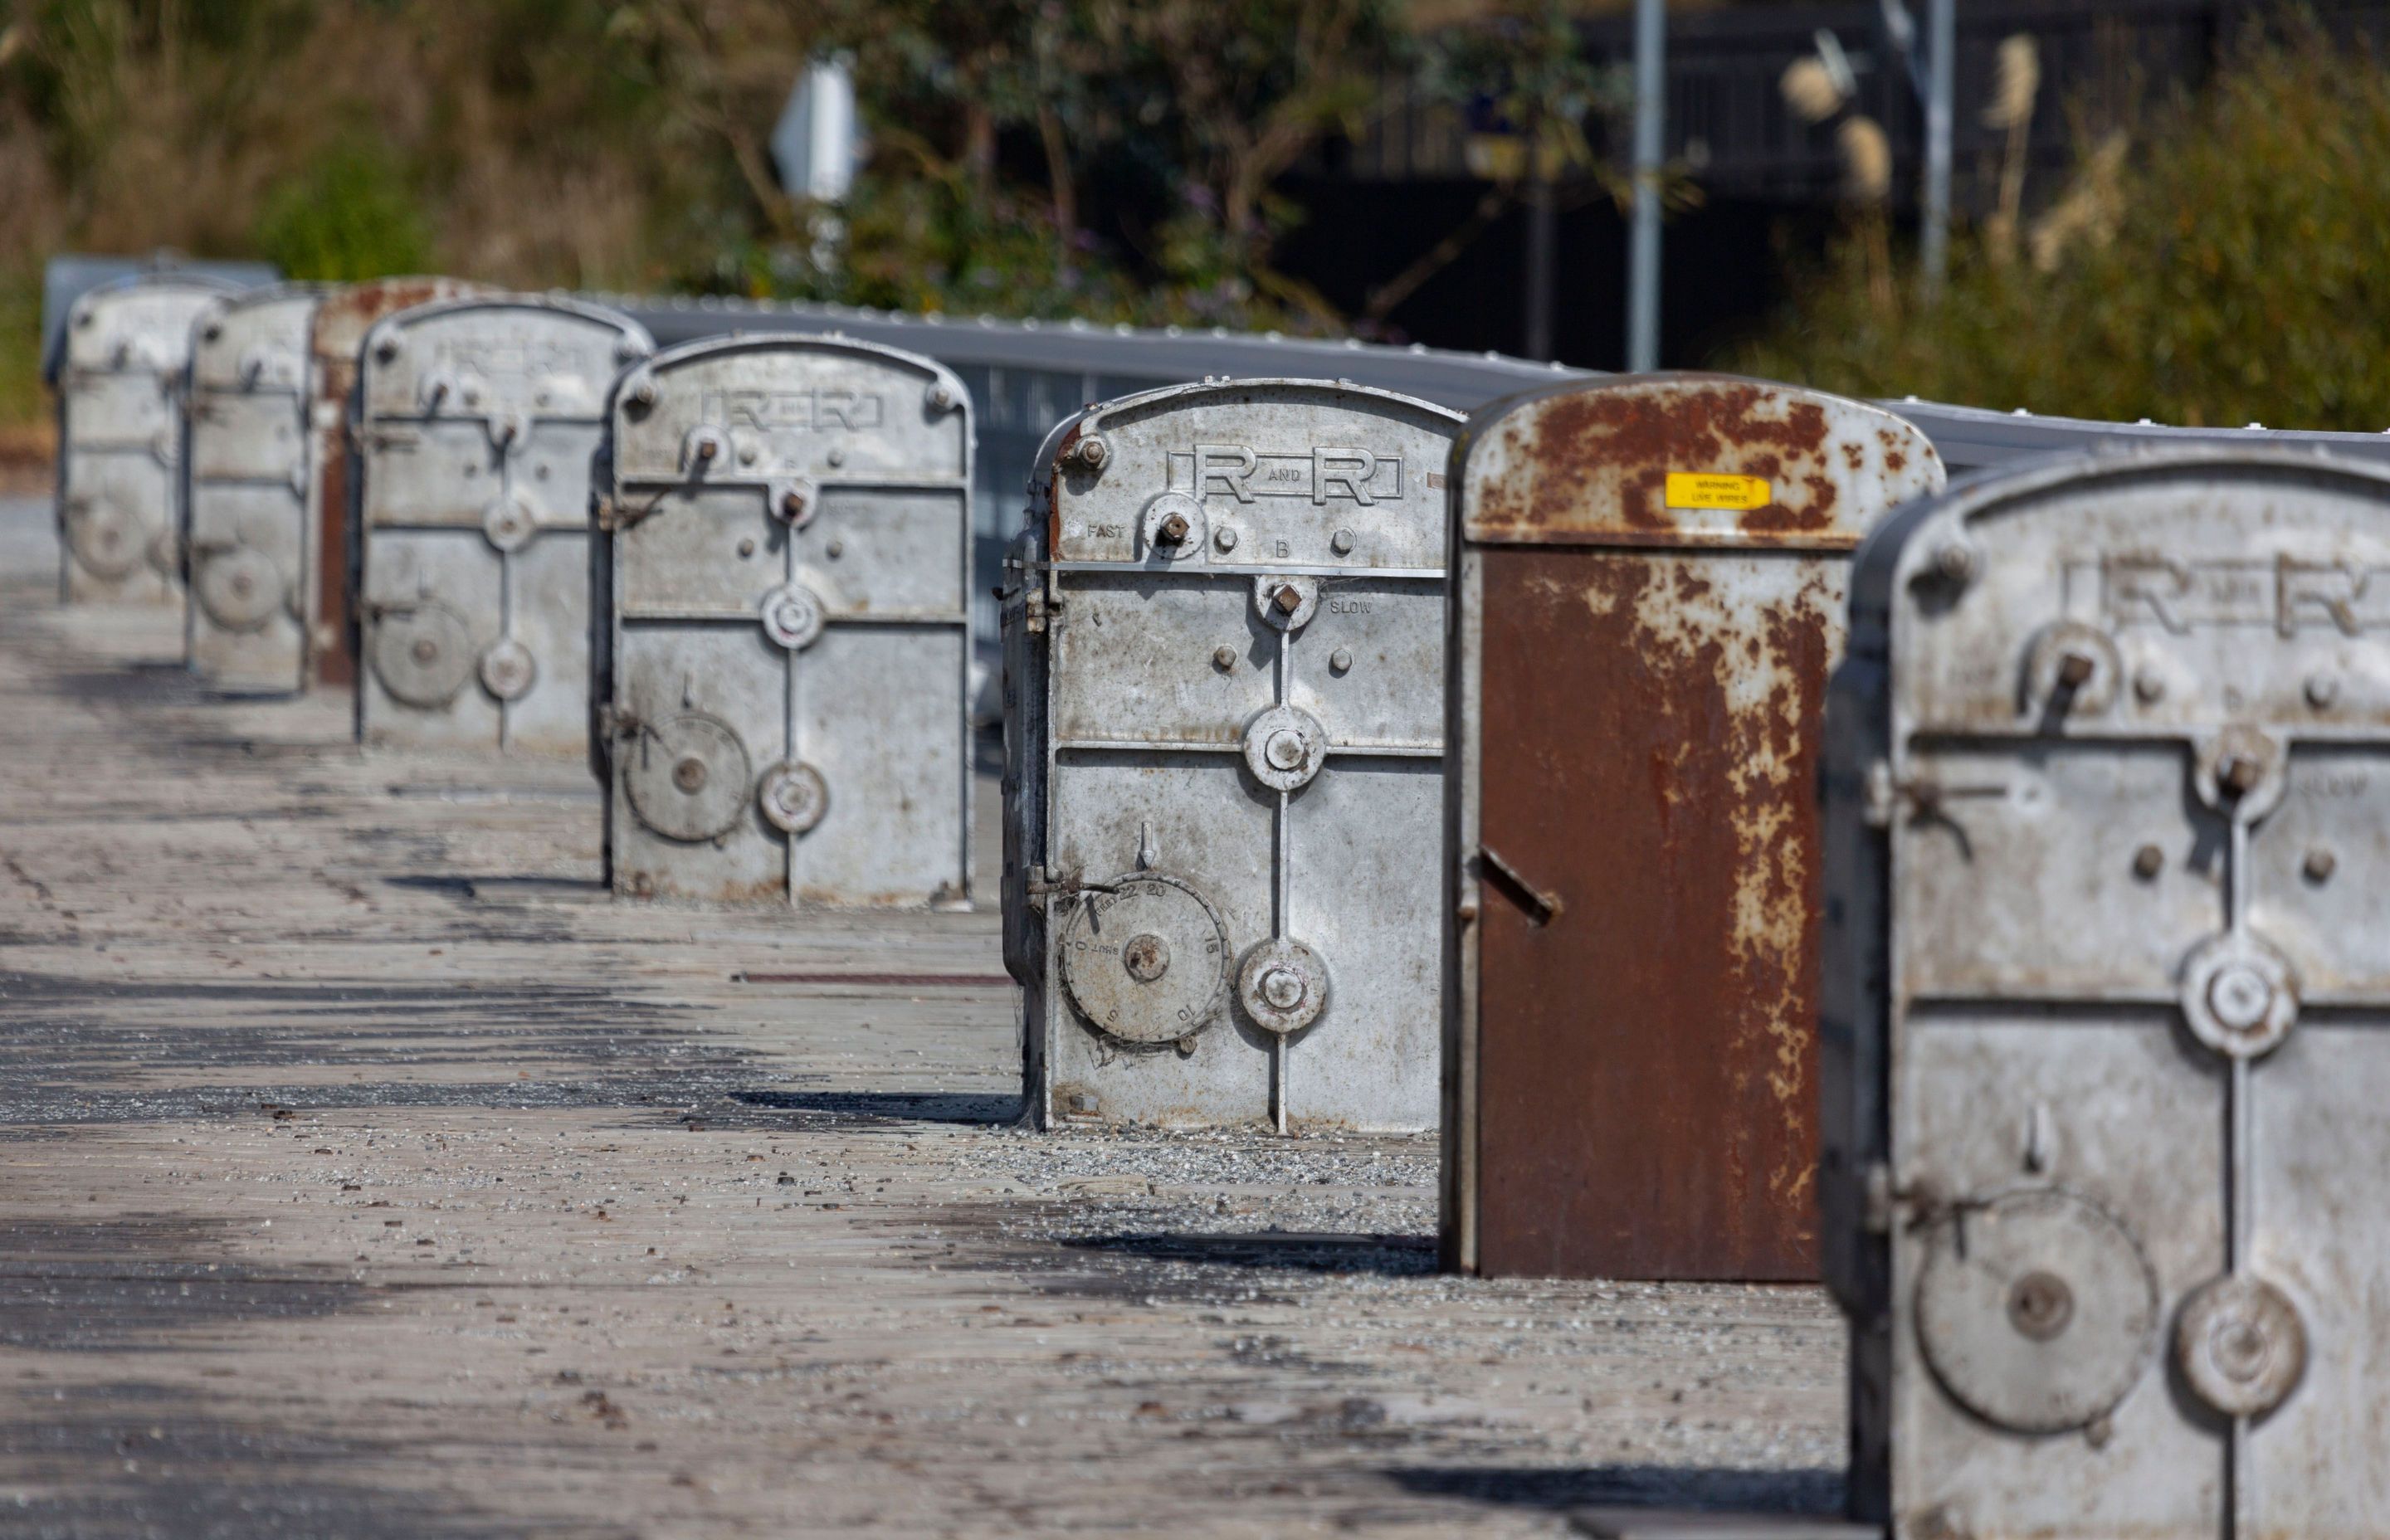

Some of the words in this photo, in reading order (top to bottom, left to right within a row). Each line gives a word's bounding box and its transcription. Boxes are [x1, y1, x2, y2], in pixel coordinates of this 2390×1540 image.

[1193, 443, 1256, 504] R
[1269, 469, 1301, 481] AND
[1312, 446, 1376, 506] R
[1695, 480, 1740, 491] WARNING
[1691, 493, 1712, 503] LIVE
[1715, 494, 1748, 504] WIRES
[1088, 524, 1125, 538] FAST
[1275, 539, 1290, 558] B
[1330, 600, 1373, 614] SLOW
[1119, 885, 1138, 900] 22
[1147, 883, 1167, 897] 20
[1205, 937, 1220, 953] 15
[1178, 1004, 1196, 1021] 10
